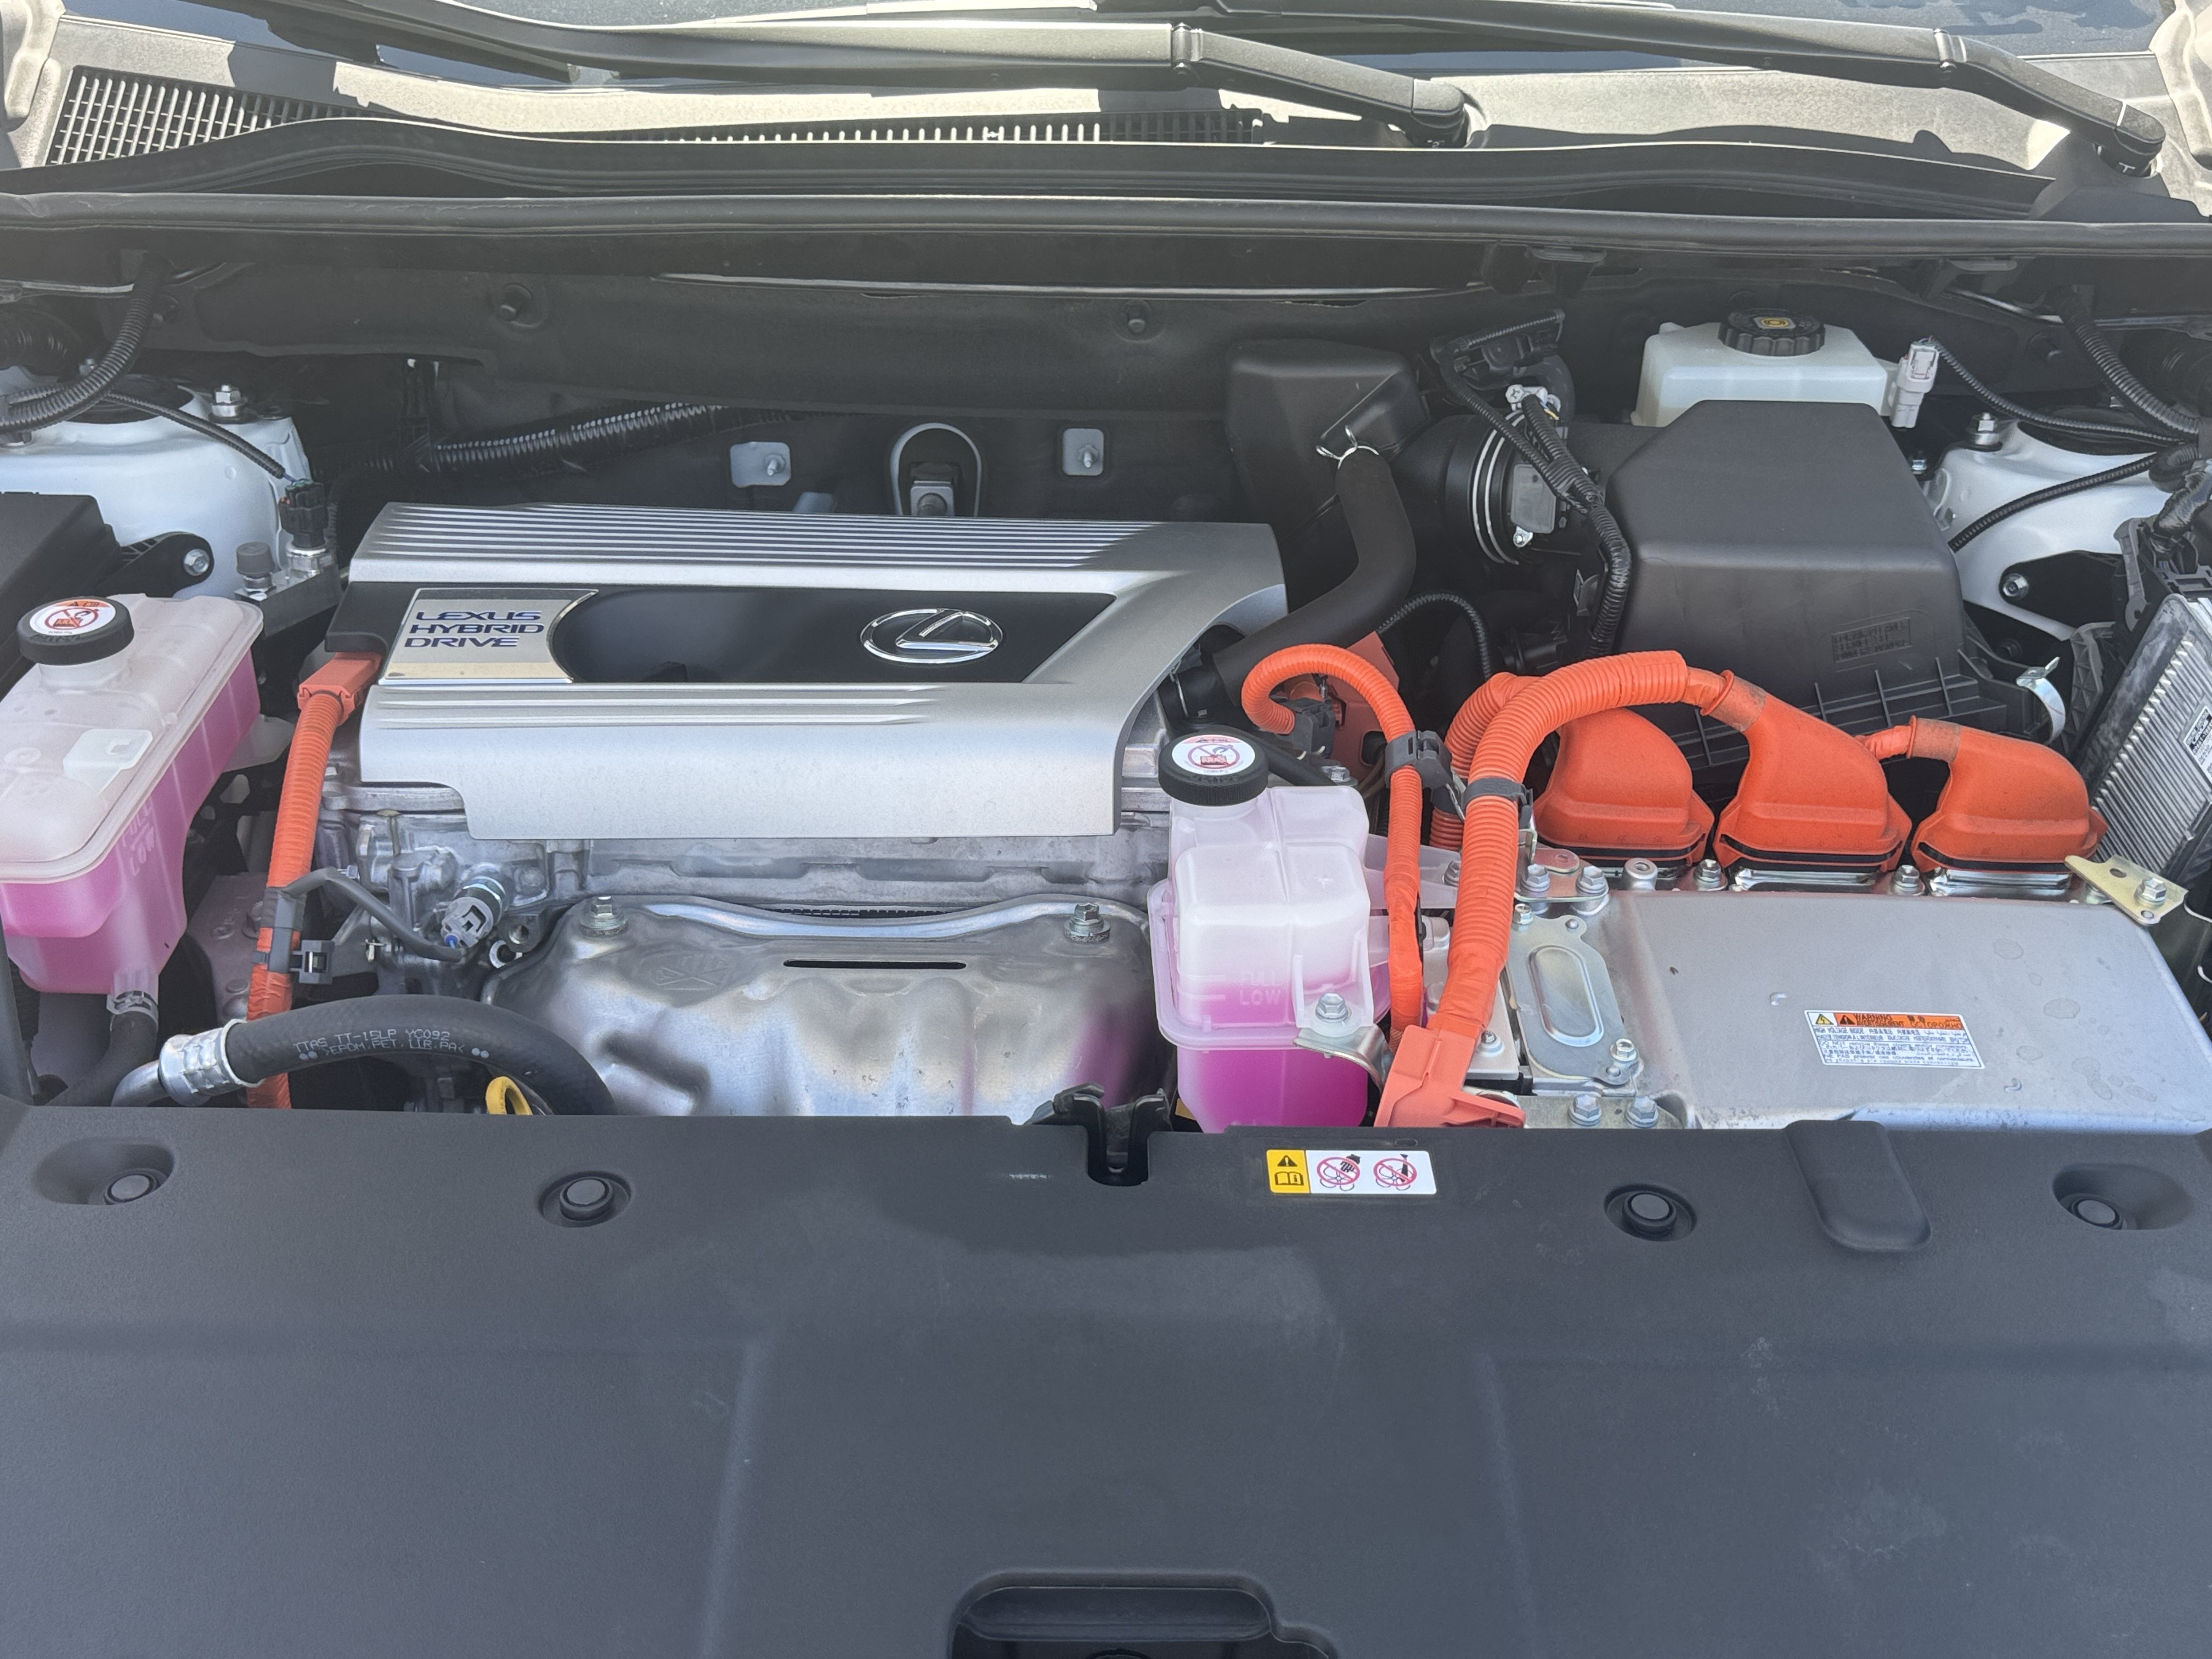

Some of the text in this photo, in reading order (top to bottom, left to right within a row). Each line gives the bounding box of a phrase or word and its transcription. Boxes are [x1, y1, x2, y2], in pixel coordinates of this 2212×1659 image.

[416, 610, 543, 621] LEXUS
[409, 623, 545, 634] HYBRID
[404, 636, 521, 648] DRIVE
[1239, 989, 1282, 1006] LOW
[292, 1037, 329, 1053] TTAS
